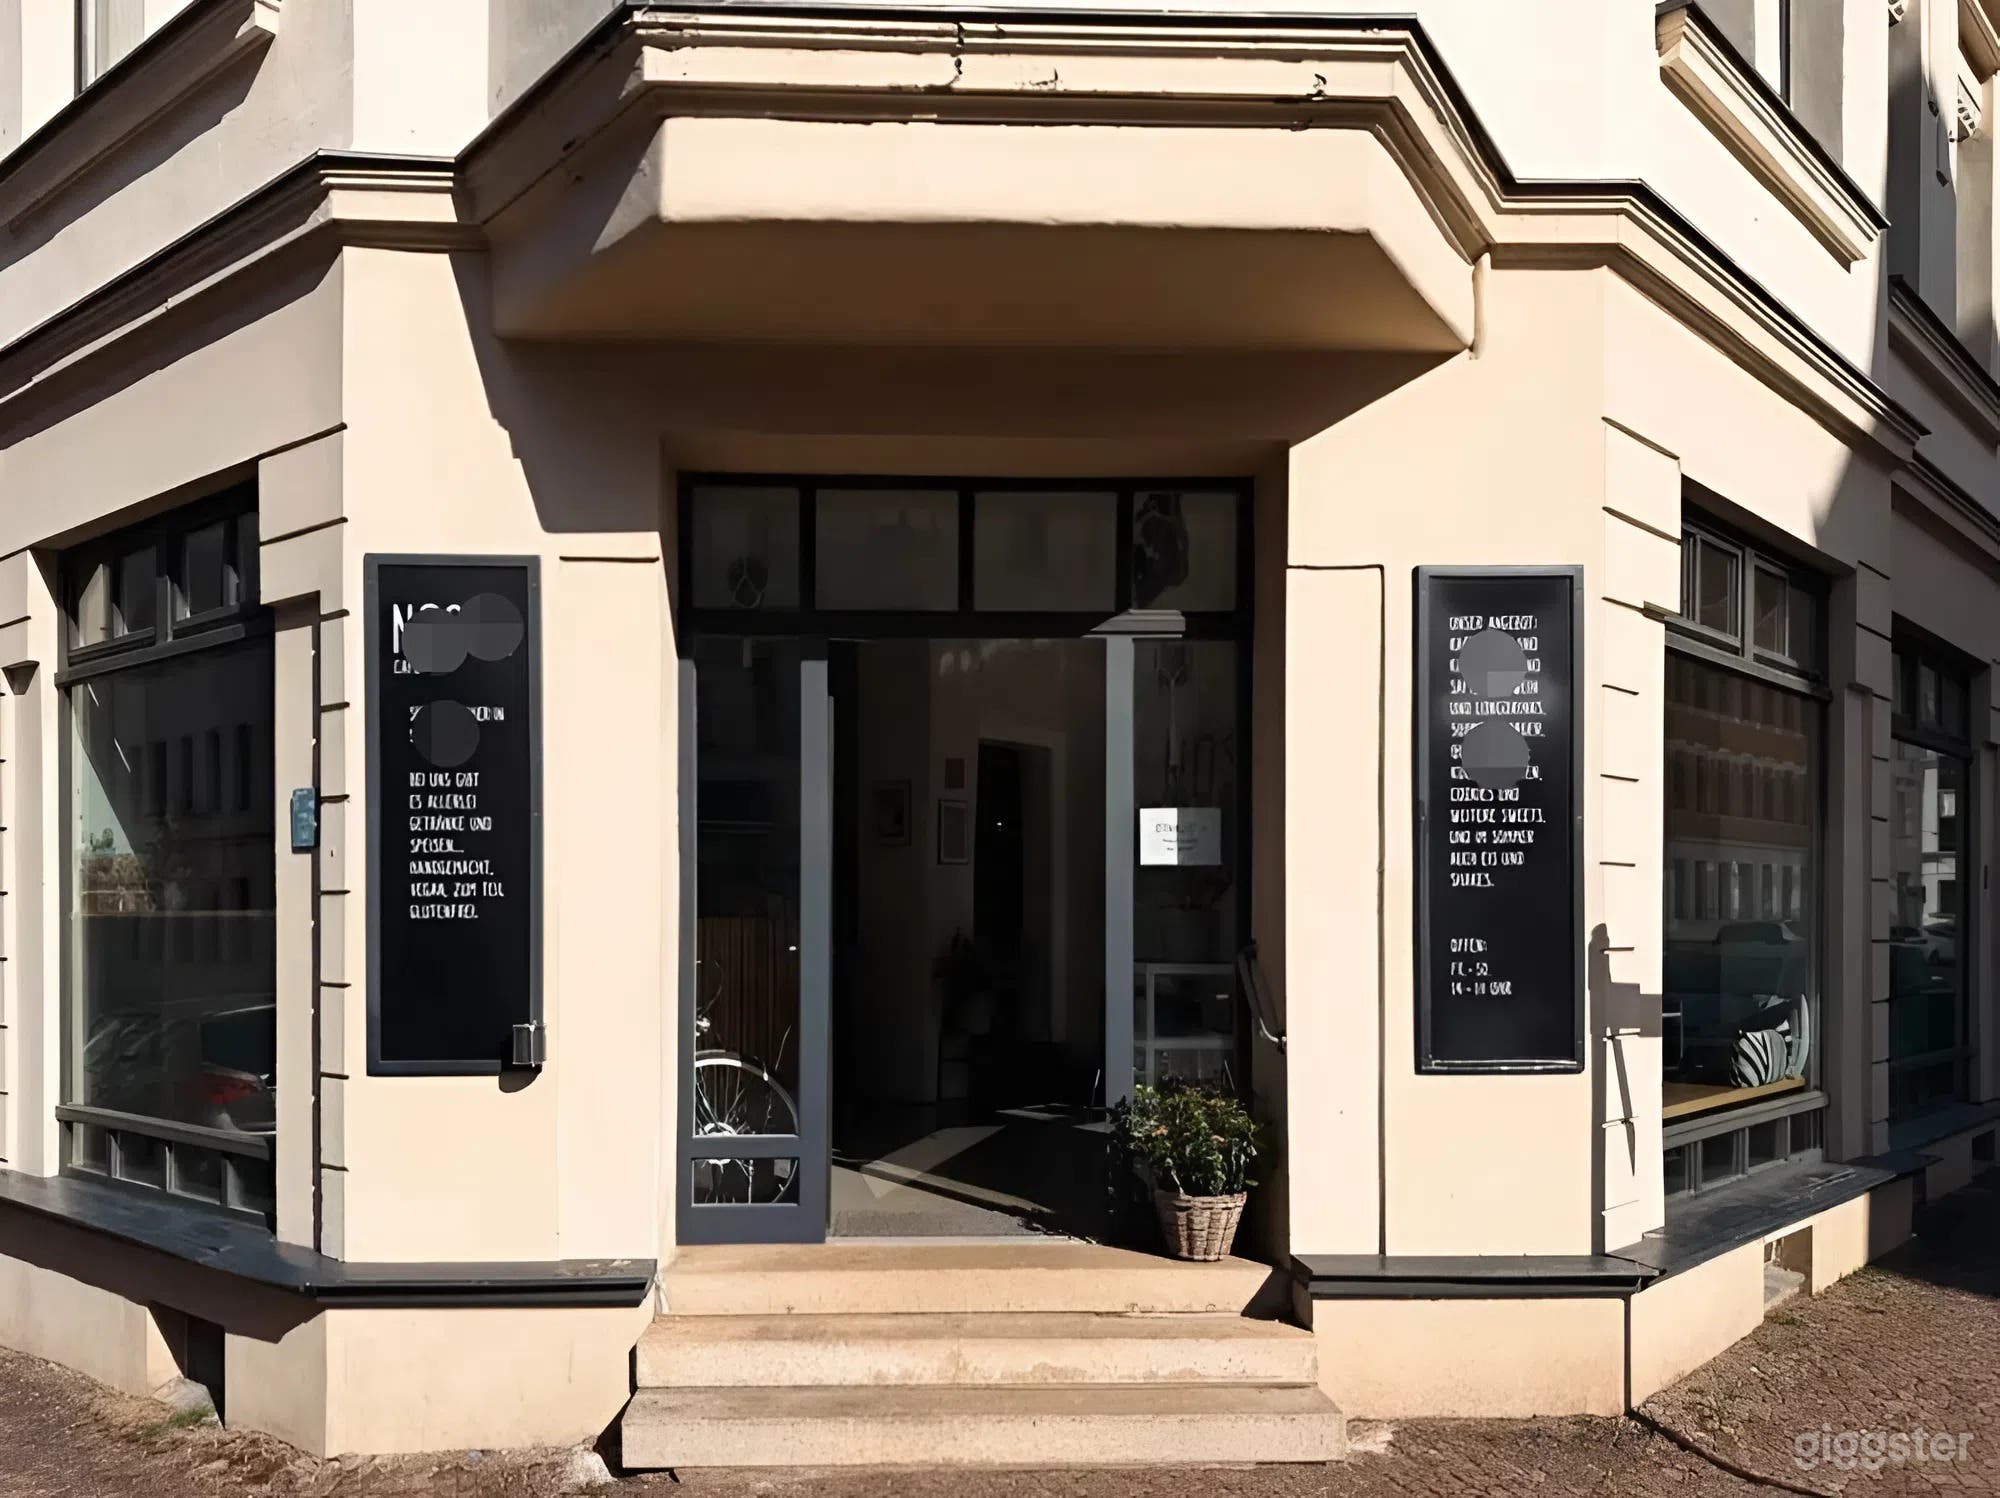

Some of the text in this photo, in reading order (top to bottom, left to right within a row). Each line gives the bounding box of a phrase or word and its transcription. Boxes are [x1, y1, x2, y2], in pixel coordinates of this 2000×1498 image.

[429, 772, 451, 787] UNS
[469, 816, 492, 831] UND
[1501, 851, 1525, 866] UND
